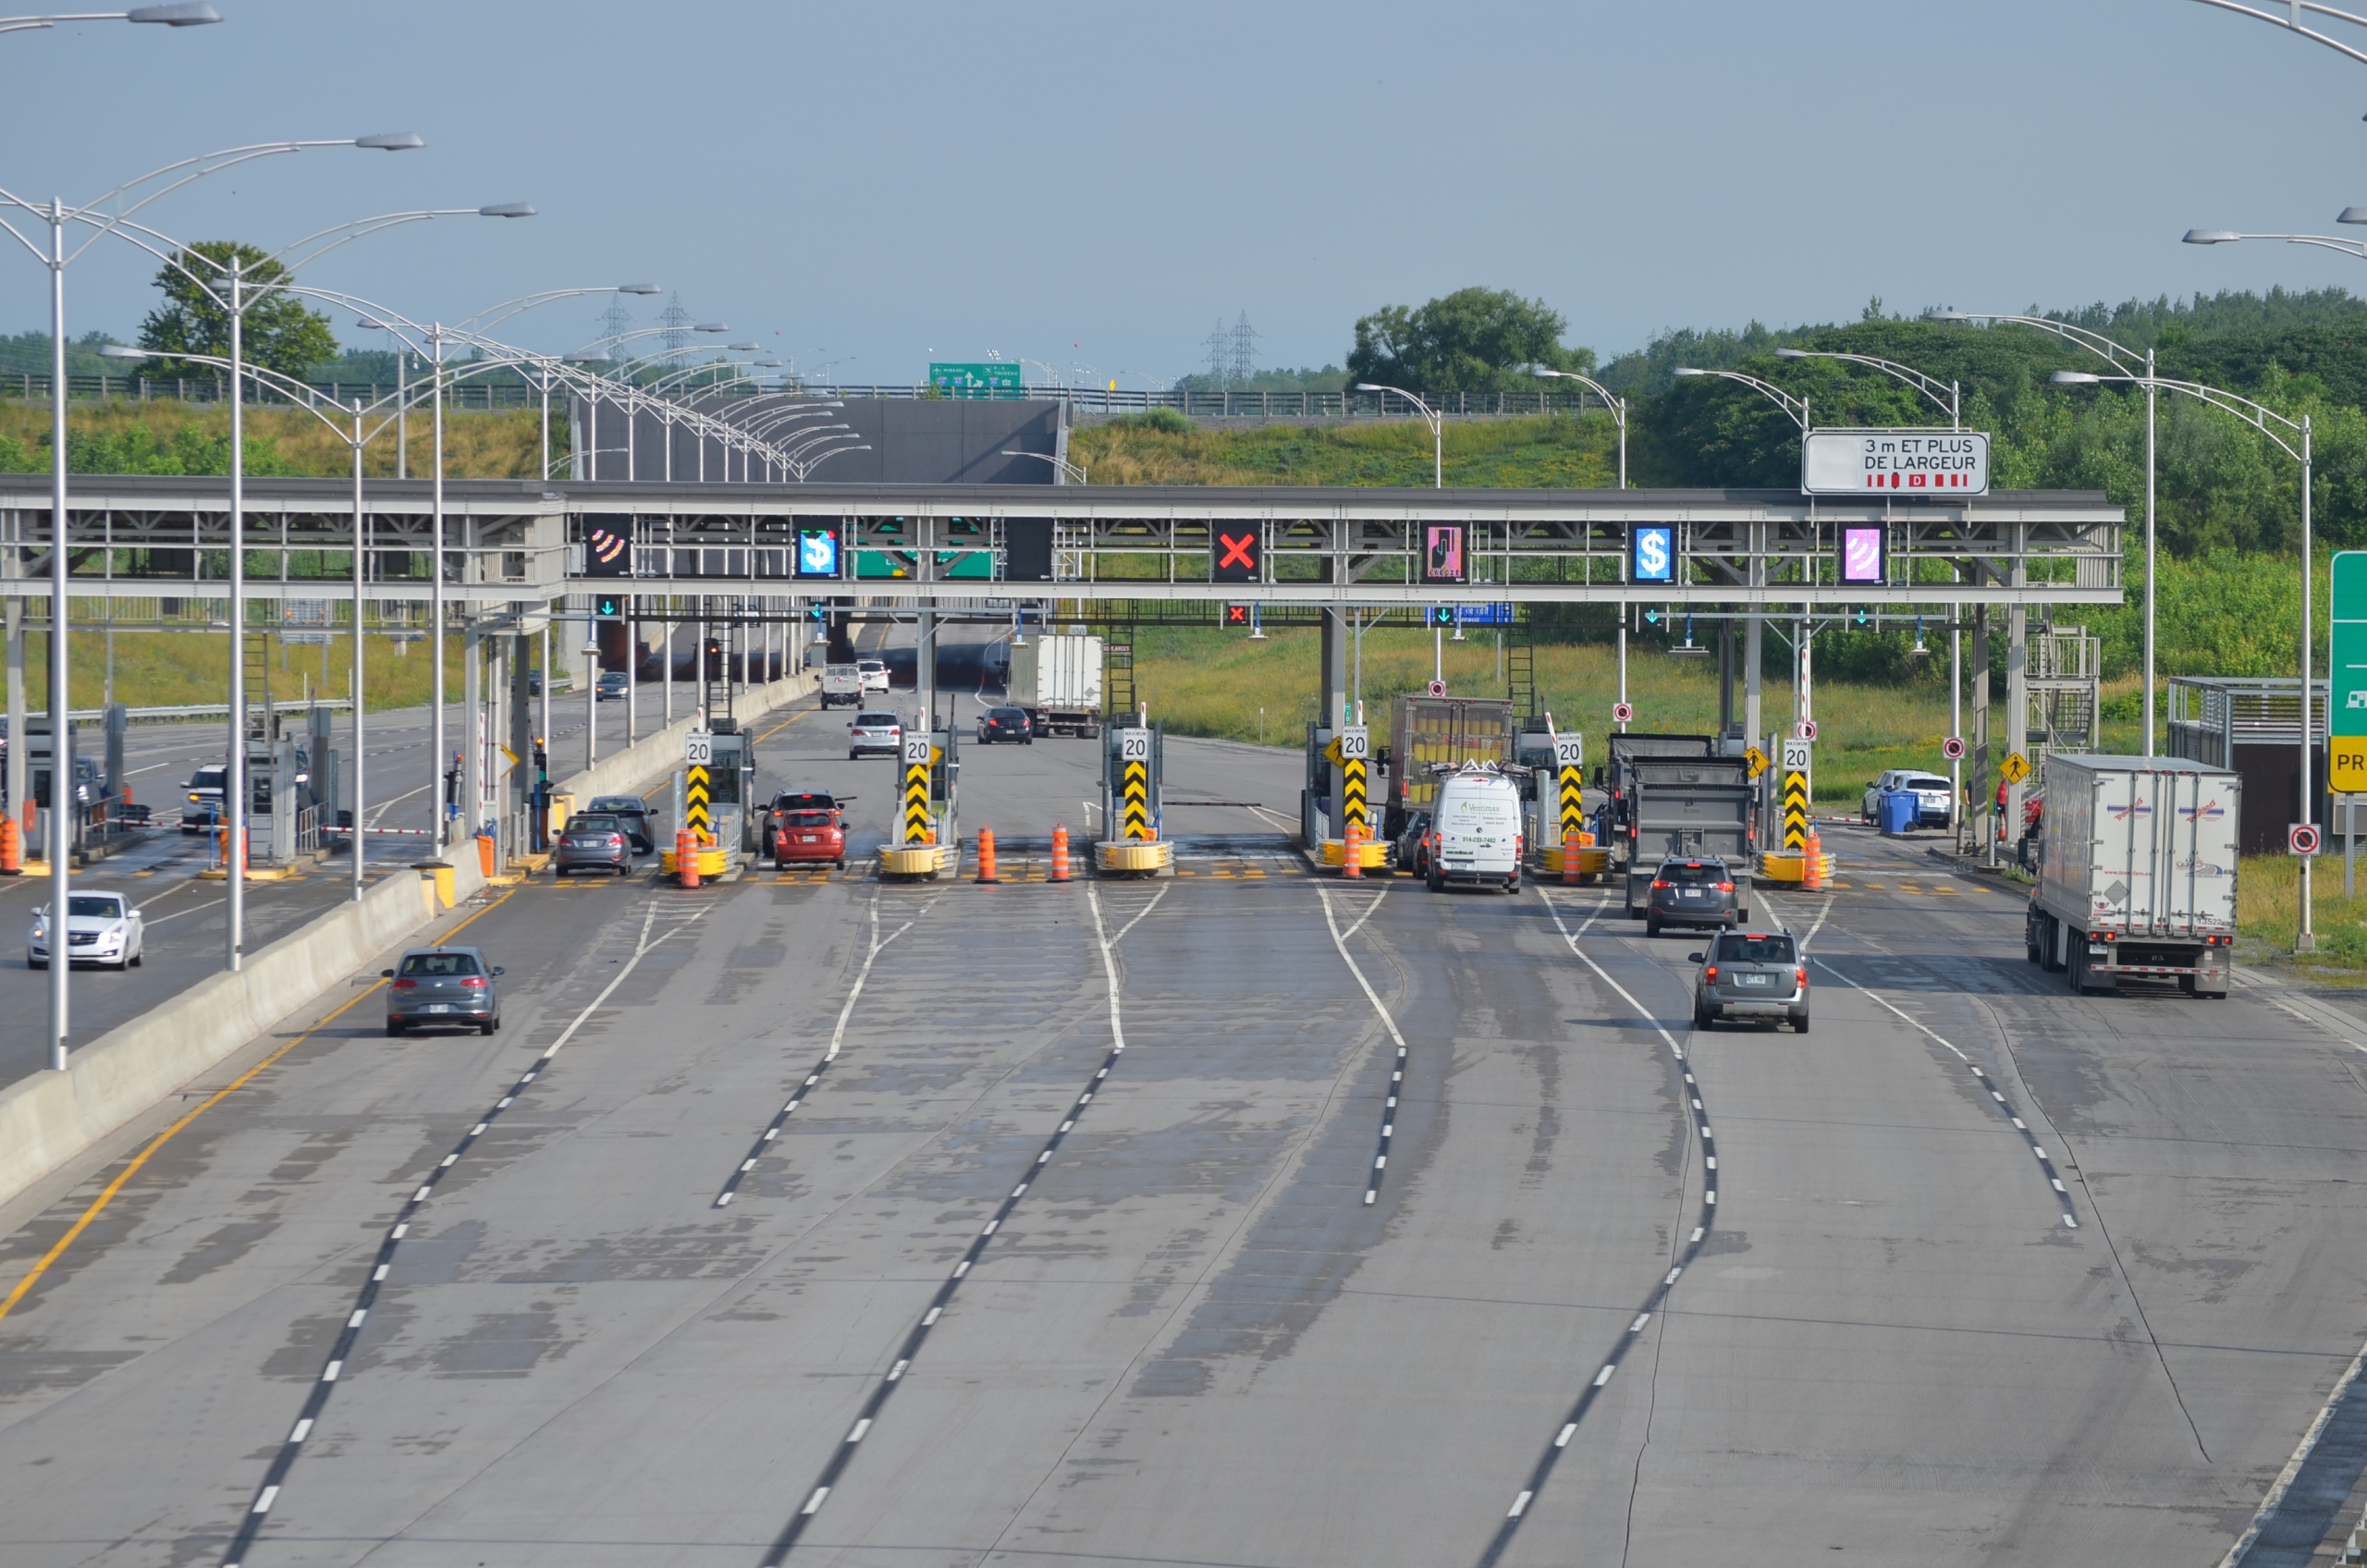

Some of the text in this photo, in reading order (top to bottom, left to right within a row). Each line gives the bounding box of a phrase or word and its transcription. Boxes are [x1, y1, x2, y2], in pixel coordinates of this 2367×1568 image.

[1865, 439, 1973, 453] 3 m ET PLUS
[1865, 456, 1976, 470] DE LARGEUR
[1913, 476, 1921, 485] D
[1641, 530, 1667, 577] $
[688, 743, 708, 760] 20
[907, 741, 928, 759] 20
[1125, 739, 1146, 756] 20
[1345, 737, 1365, 753] 20
[1559, 743, 1580, 761] 20
[1786, 749, 1807, 766] 20
[2337, 753, 2364, 771] PR
[1468, 803, 1501, 812] Ventimax
